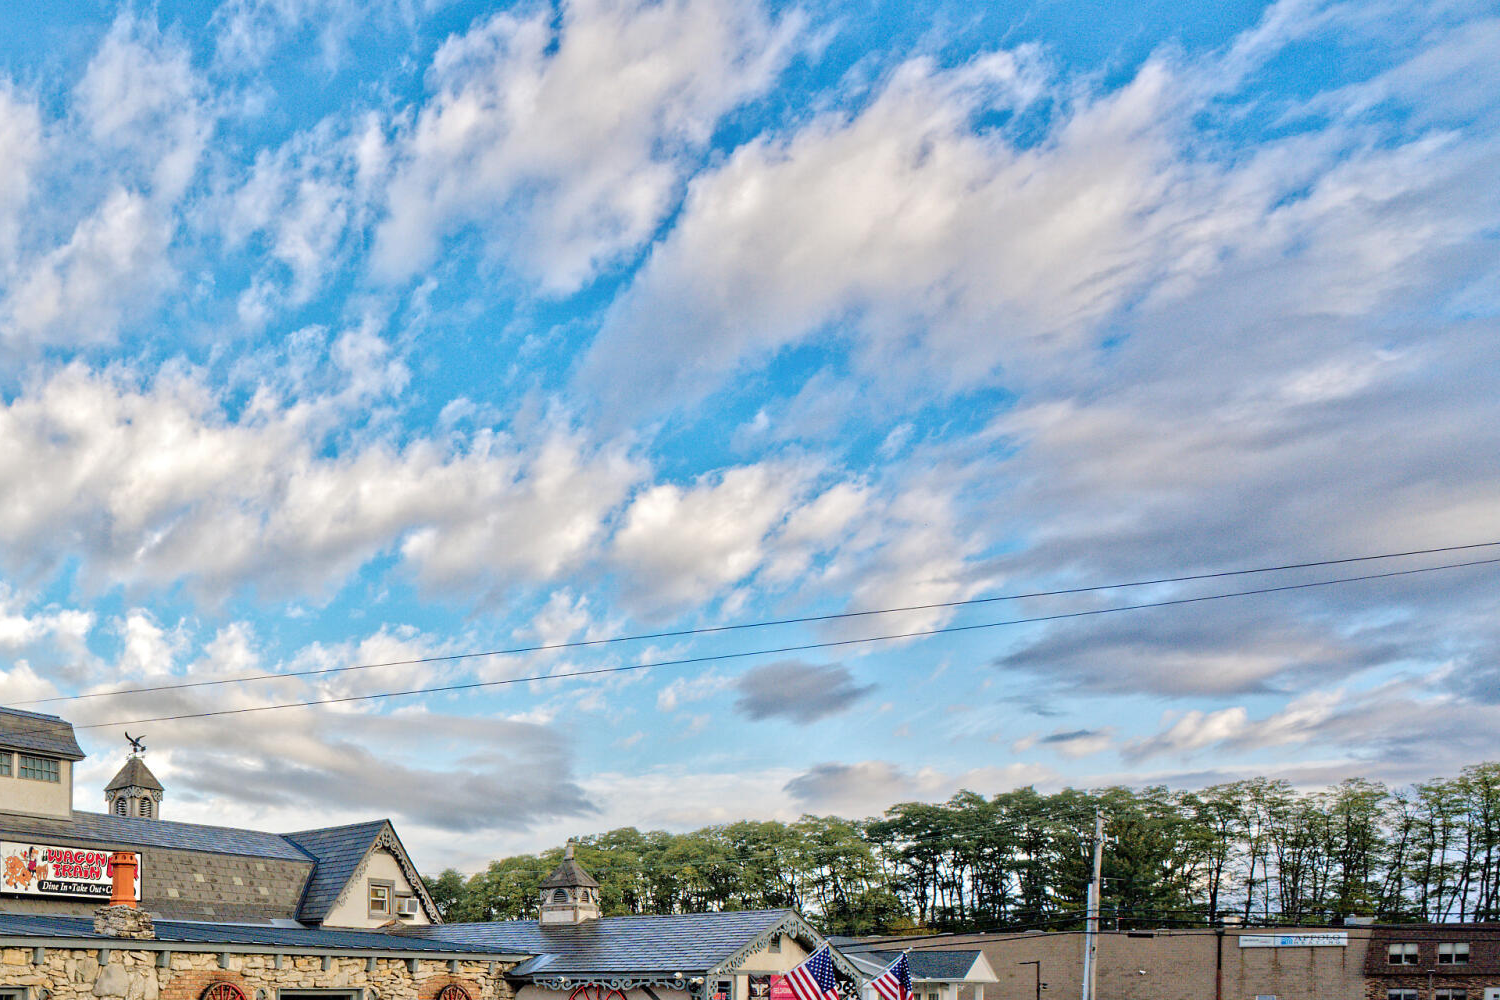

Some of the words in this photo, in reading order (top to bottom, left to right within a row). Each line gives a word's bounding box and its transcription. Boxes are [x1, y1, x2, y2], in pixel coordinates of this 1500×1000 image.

[46, 848, 107, 867] WAGON
[42, 881, 60, 891] Dine
[60, 882, 68, 891] In
[71, 883, 88, 893] Take
[89, 884, 102, 893] Out
